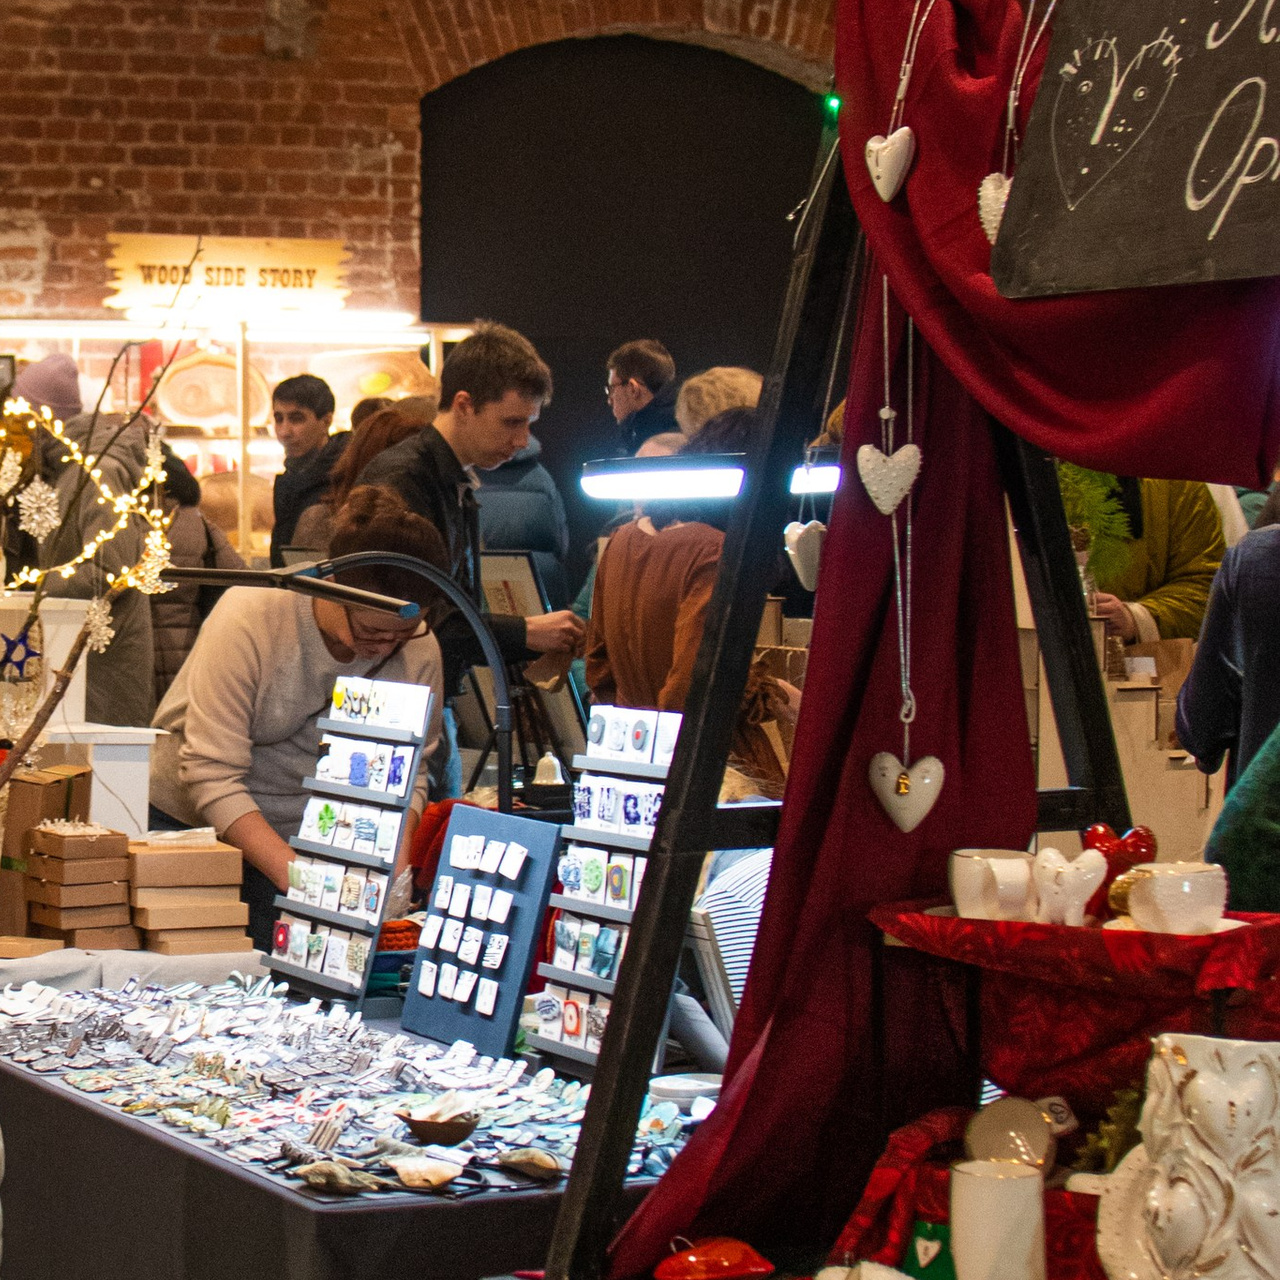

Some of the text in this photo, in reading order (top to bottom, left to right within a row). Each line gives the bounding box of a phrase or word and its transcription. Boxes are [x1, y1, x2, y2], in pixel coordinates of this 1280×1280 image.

[138, 265, 317, 288] WOOD SIDE STORY
